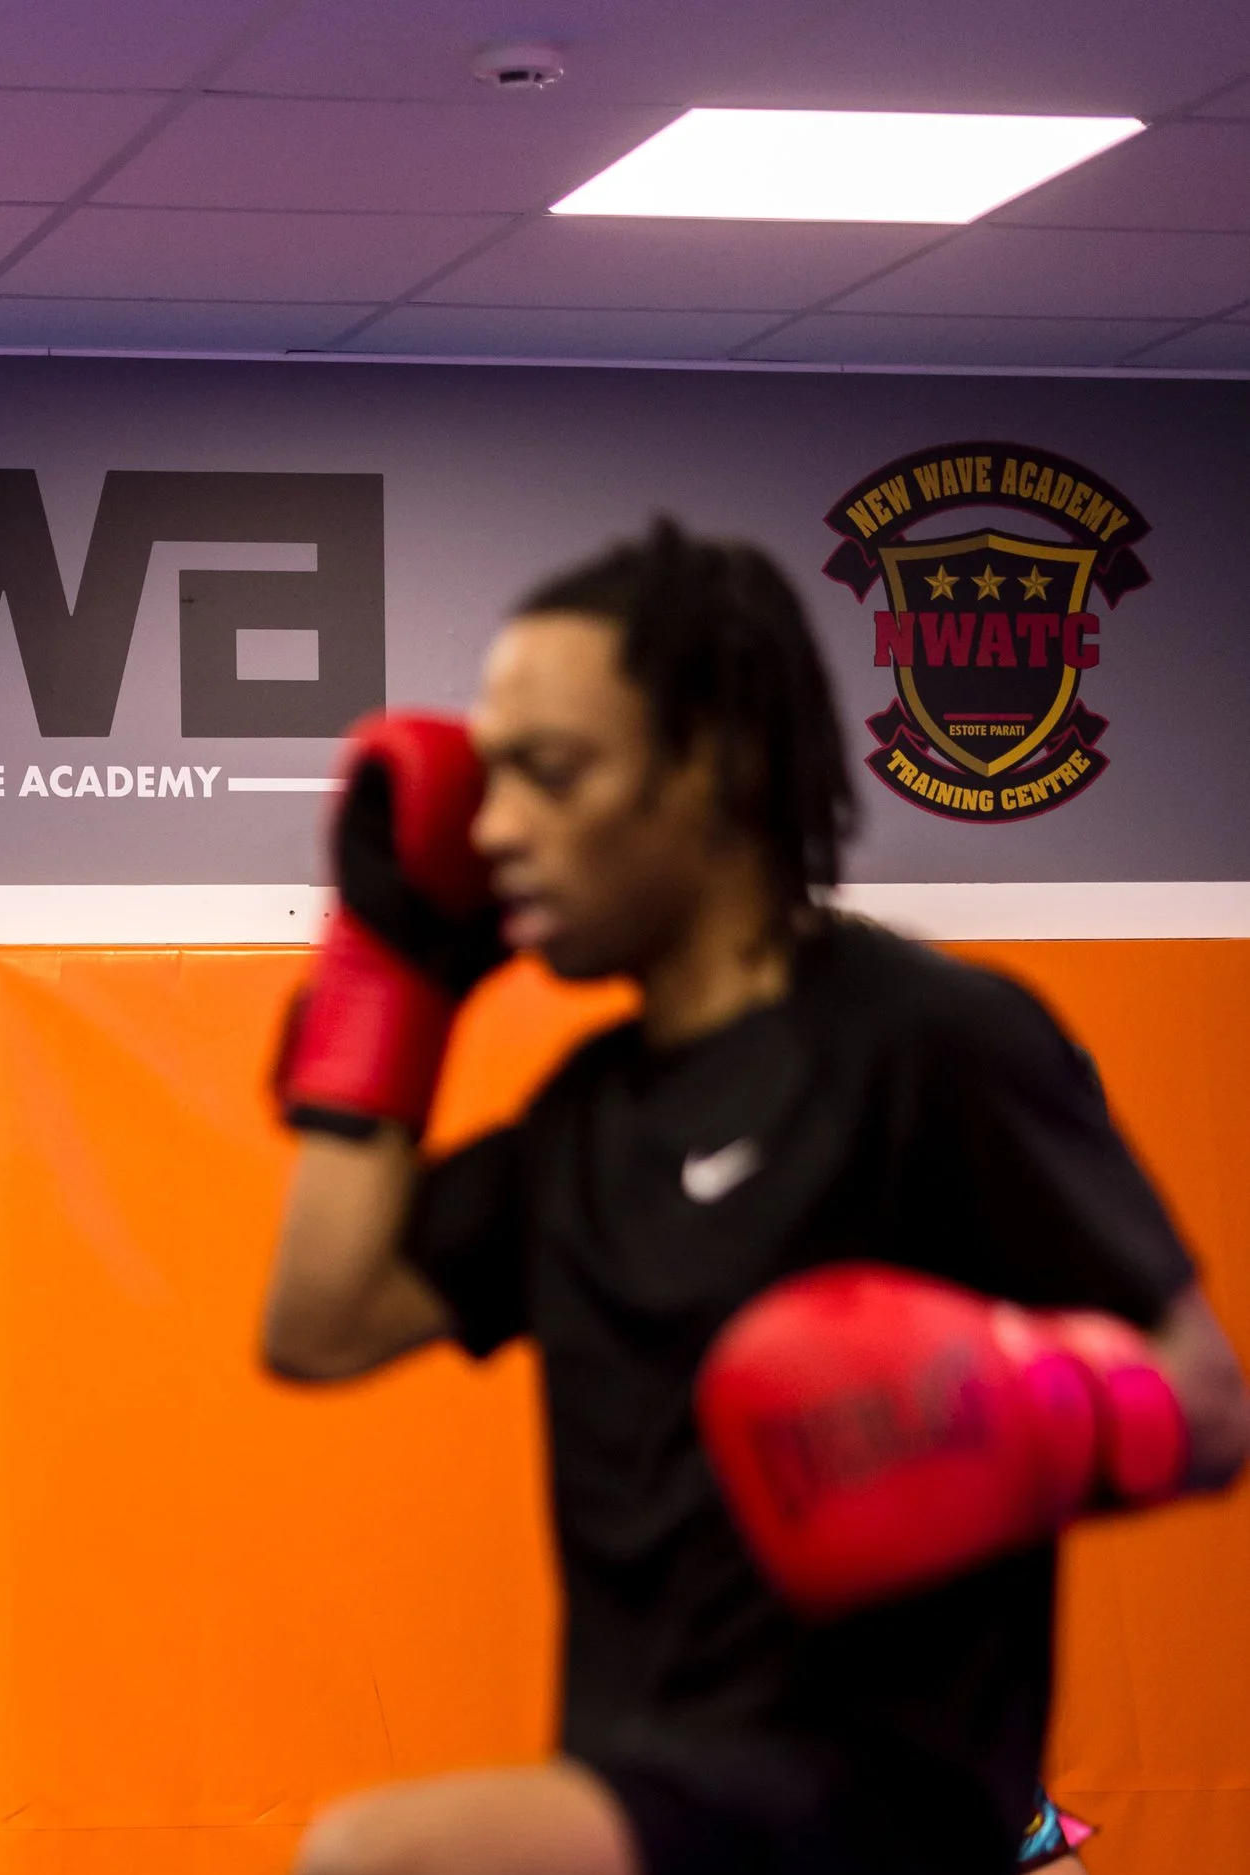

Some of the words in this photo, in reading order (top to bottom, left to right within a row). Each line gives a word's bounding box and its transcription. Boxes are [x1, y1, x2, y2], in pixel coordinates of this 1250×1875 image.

[846, 474, 912, 539] NEW
[913, 456, 992, 502] WAVE
[1000, 458, 1130, 543] ACADEMY
[873, 611, 1100, 669] NWATC
[949, 724, 987, 737] ESTOTE
[990, 724, 1026, 737] PARATI
[18, 765, 223, 799] ACADEMY
[886, 748, 995, 813] TRAINING
[1001, 749, 1092, 811] CENTRE
